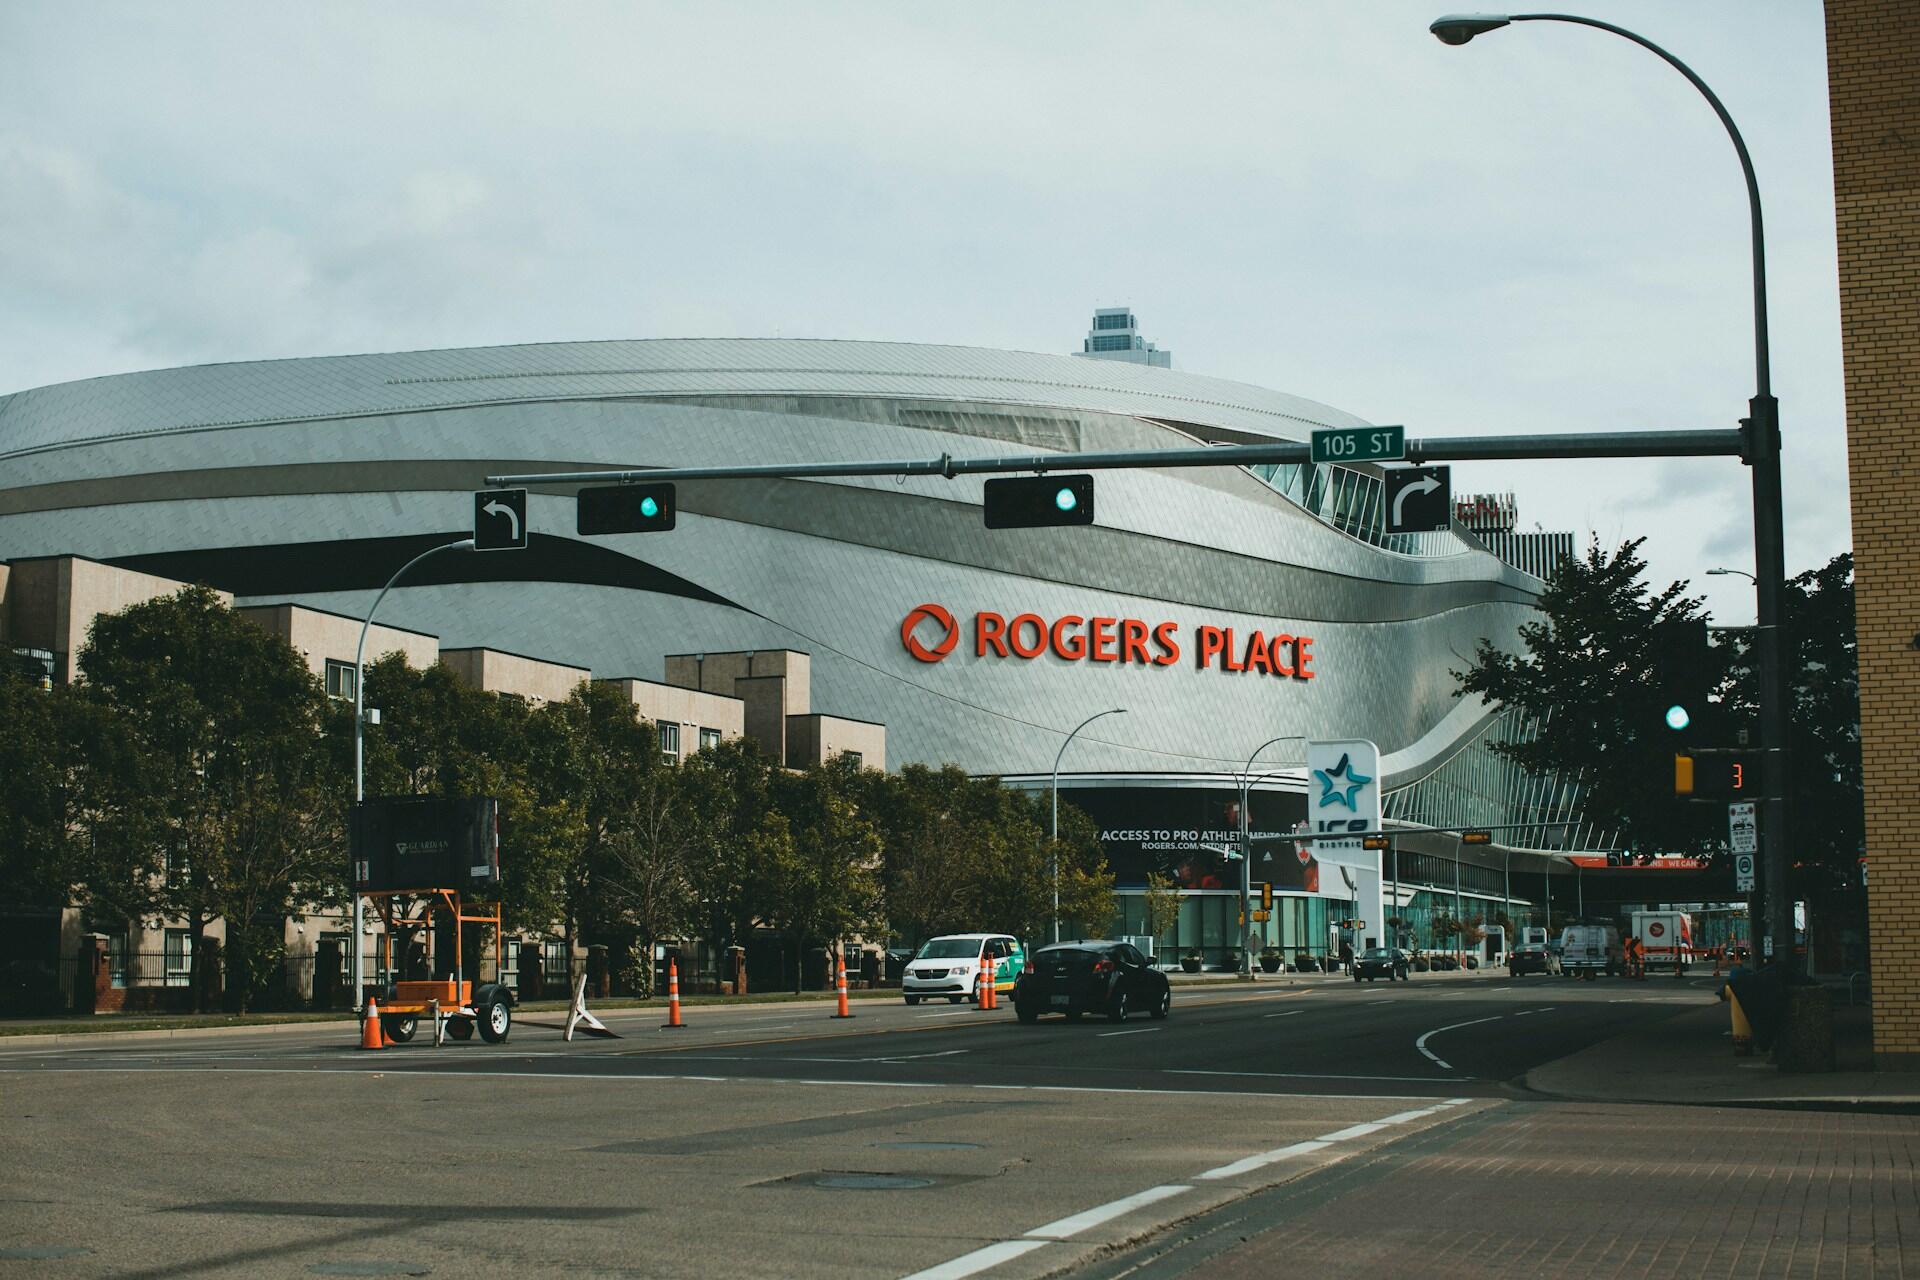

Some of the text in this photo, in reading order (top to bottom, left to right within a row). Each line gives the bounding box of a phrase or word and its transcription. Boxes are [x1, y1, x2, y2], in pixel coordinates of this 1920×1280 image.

[1322, 432, 1393, 457] 105 ST
[974, 610, 1316, 680] ROGERS PLACE
[1732, 763, 1742, 789] 3
[1101, 830, 1150, 841] ACCESS
[1152, 830, 1171, 841] TO
[1173, 830, 1199, 841] PRO
[1201, 830, 1243, 841] ATHLET
[1319, 841, 1362, 849] DISTRIC
